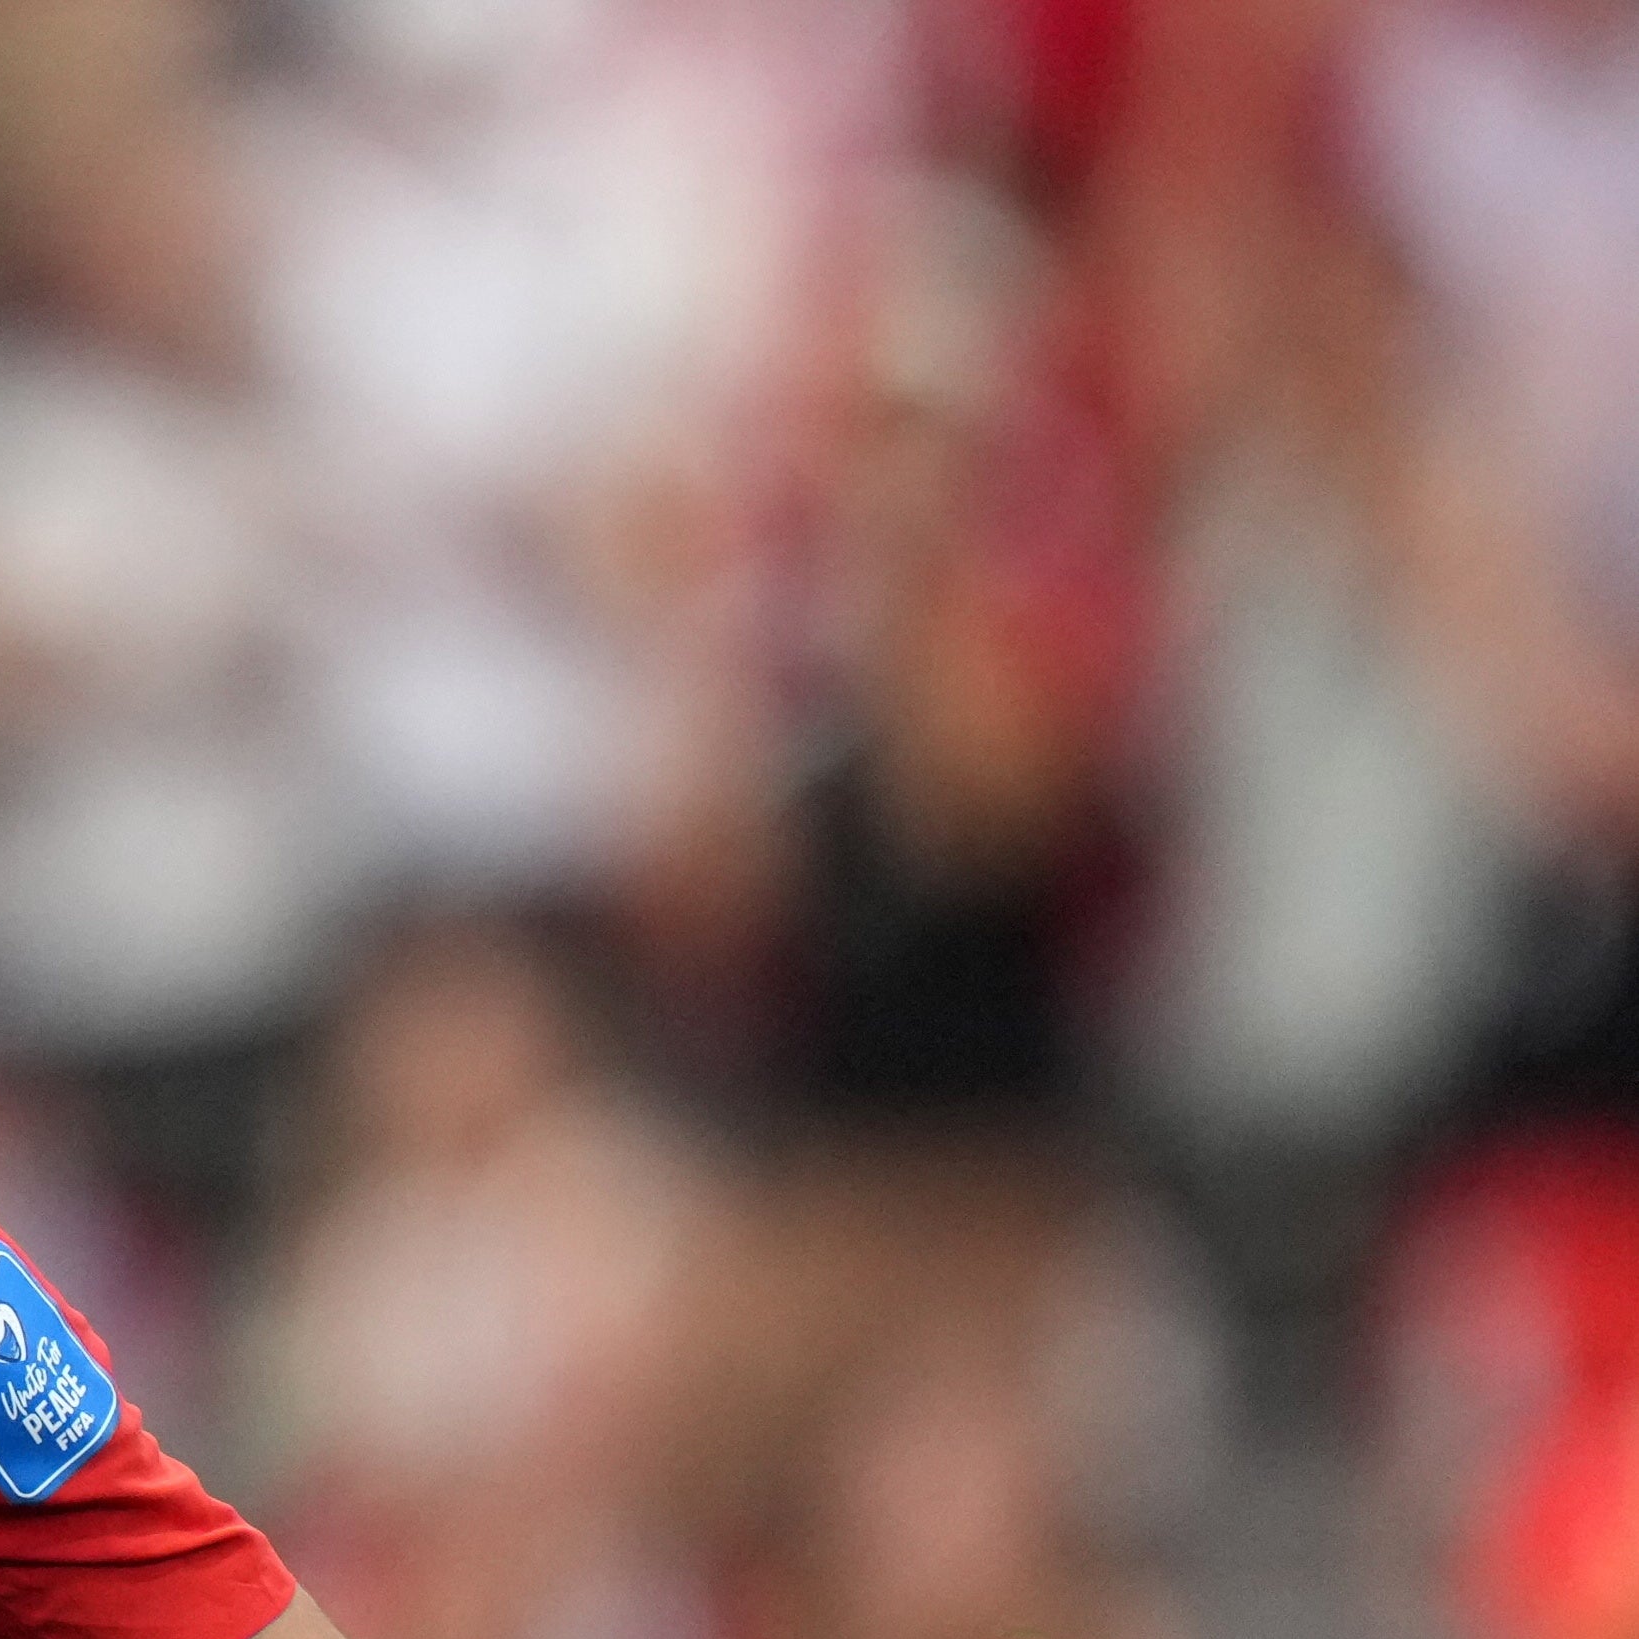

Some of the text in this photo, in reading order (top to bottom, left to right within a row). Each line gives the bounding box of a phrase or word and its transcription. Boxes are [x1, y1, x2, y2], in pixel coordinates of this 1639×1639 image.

[0, 1336, 63, 1421] Unite For
[22, 1365, 88, 1445] PEACE
[56, 1412, 96, 1452] FIFA
